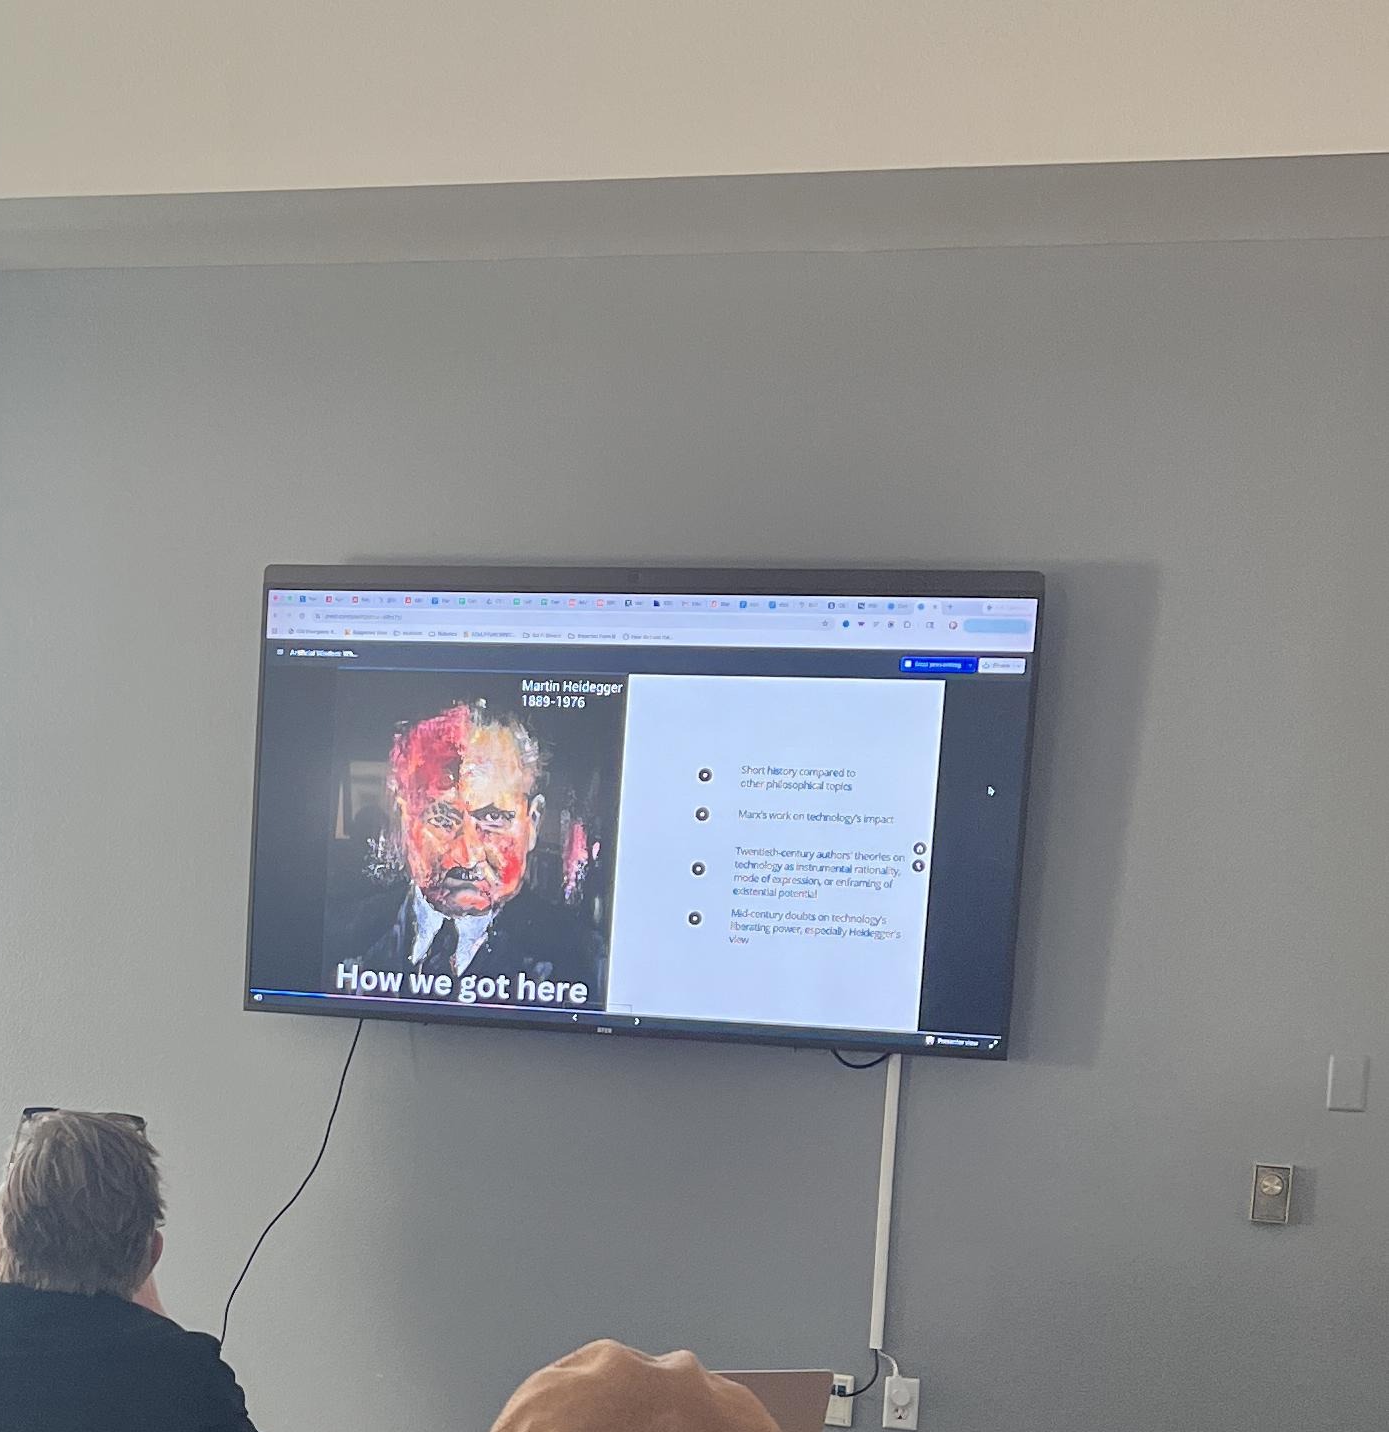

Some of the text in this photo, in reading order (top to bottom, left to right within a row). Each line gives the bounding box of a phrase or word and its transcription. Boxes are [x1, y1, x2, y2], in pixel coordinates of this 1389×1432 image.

[522, 679, 624, 697] Martin Heidegger
[522, 694, 586, 709] 1889-1976
[741, 765, 856, 779] Short history compared to
[740, 779, 853, 793] other philosophical topics
[738, 810, 894, 826] Marx's work on technology's impact
[735, 847, 905, 862] Twentieth-century authors' theories on
[734, 860, 901, 878] technology as instrumental rationality,
[733, 873, 894, 890] mode of expression, or enframing of
[732, 887, 818, 900] existential potential
[731, 909, 887, 926] Mid-century doubts on technology's
[730, 921, 901, 940] liberating power, especially Heidegger's
[729, 935, 749, 945] view
[337, 963, 588, 1004] How we got here
